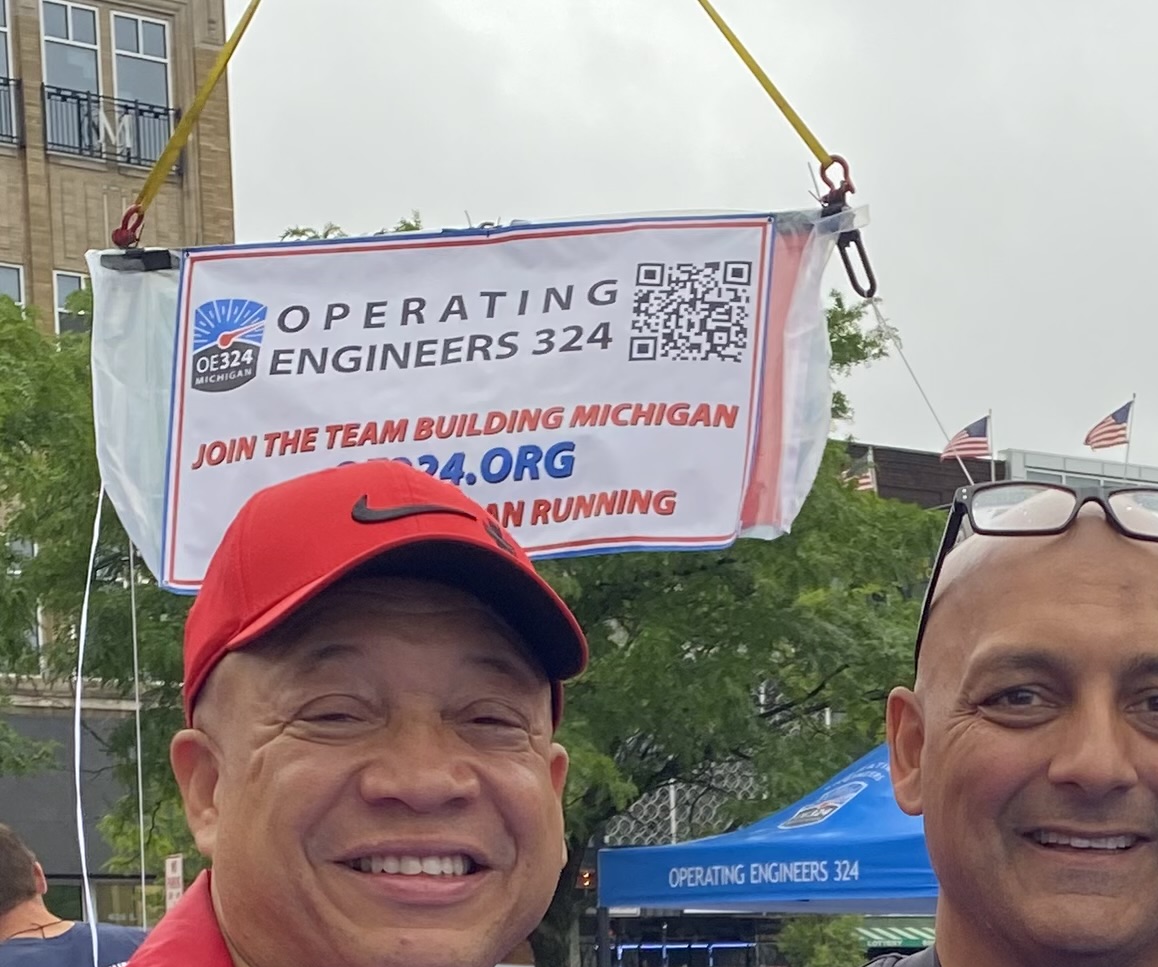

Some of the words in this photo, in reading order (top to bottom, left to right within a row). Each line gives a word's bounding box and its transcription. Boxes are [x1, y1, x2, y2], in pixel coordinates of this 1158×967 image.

[277, 279, 618, 333] OPERATING
[196, 349, 253, 373] OE324
[269, 331, 519, 375] ENGINEERS
[532, 322, 613, 356] 324
[194, 369, 252, 385] MICHIGAN
[191, 436, 257, 470] JOIN
[264, 427, 319, 457] THE
[325, 418, 409, 450] TEAM
[412, 406, 565, 441] BUILDING
[569, 403, 739, 428] MICHIGAN
[337, 441, 576, 486] 24.ORG
[530, 489, 677, 527] RUNNING
[669, 864, 745, 888] OPERATING
[750, 861, 828, 884] ENGINEERS
[833, 860, 860, 882] 324
